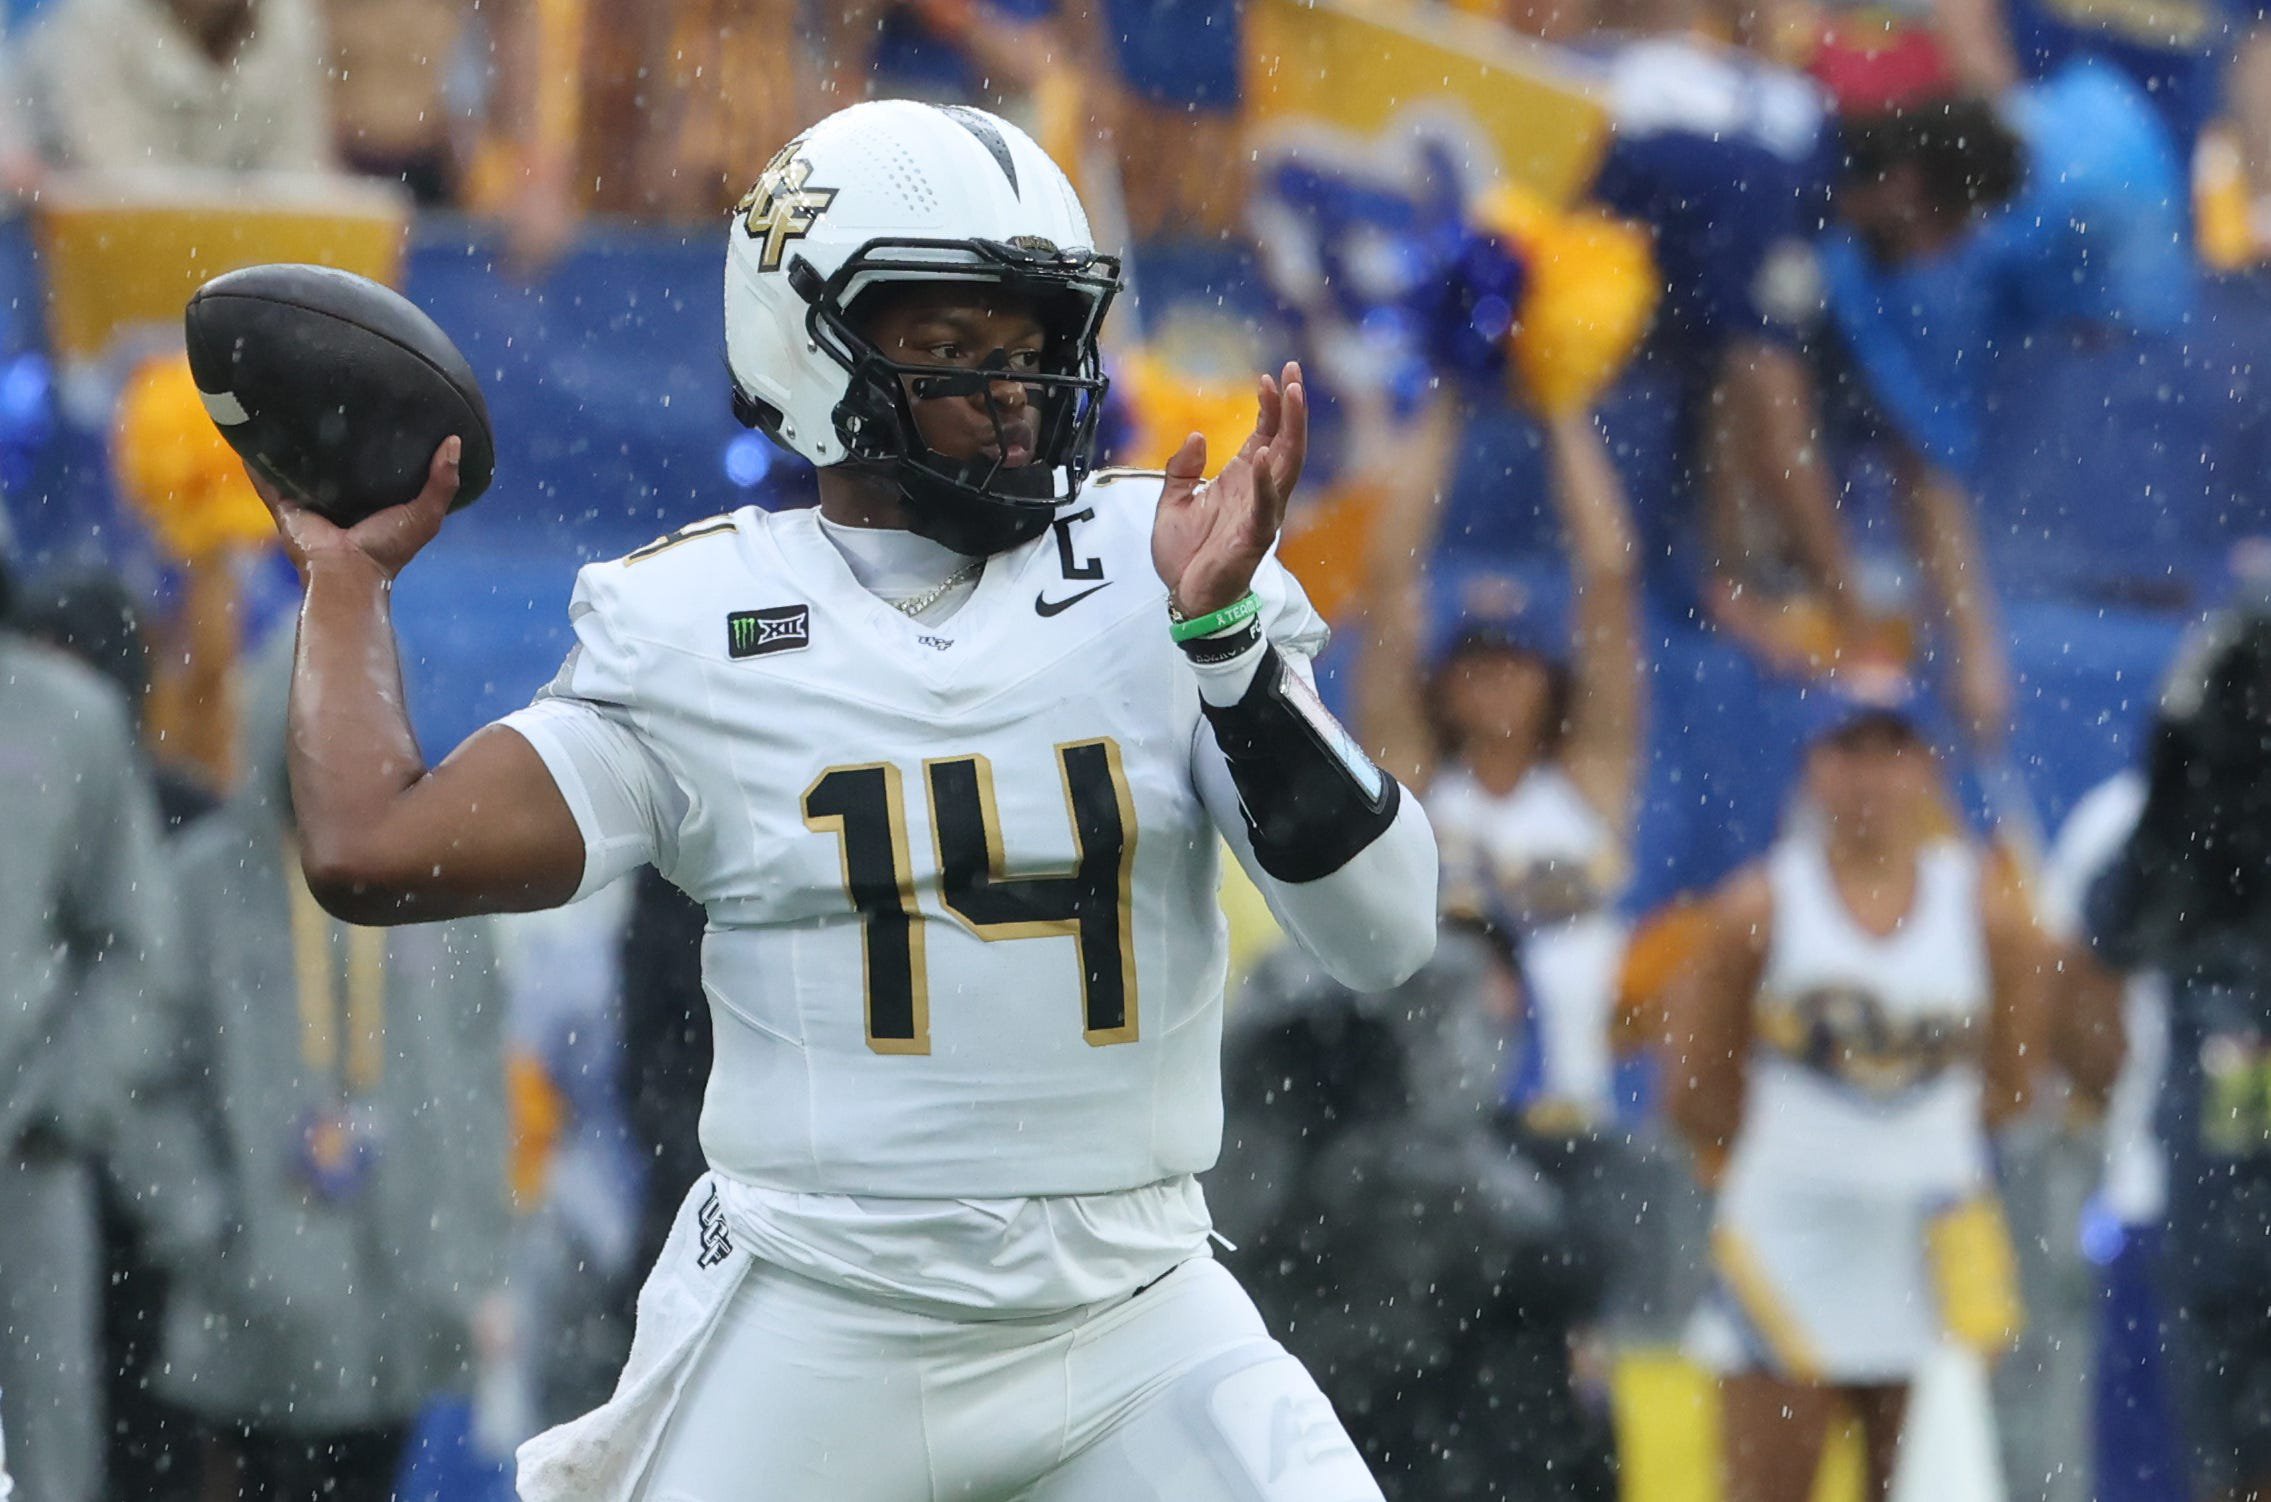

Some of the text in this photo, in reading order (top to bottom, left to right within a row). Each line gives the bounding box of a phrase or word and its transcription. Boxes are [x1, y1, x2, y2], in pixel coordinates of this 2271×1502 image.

[1053, 507, 1104, 579] C
[917, 635, 954, 651] UCF
[1224, 599, 1256, 621] TEAM
[800, 735, 1139, 1056] 14
[697, 1181, 733, 1270] UCF
